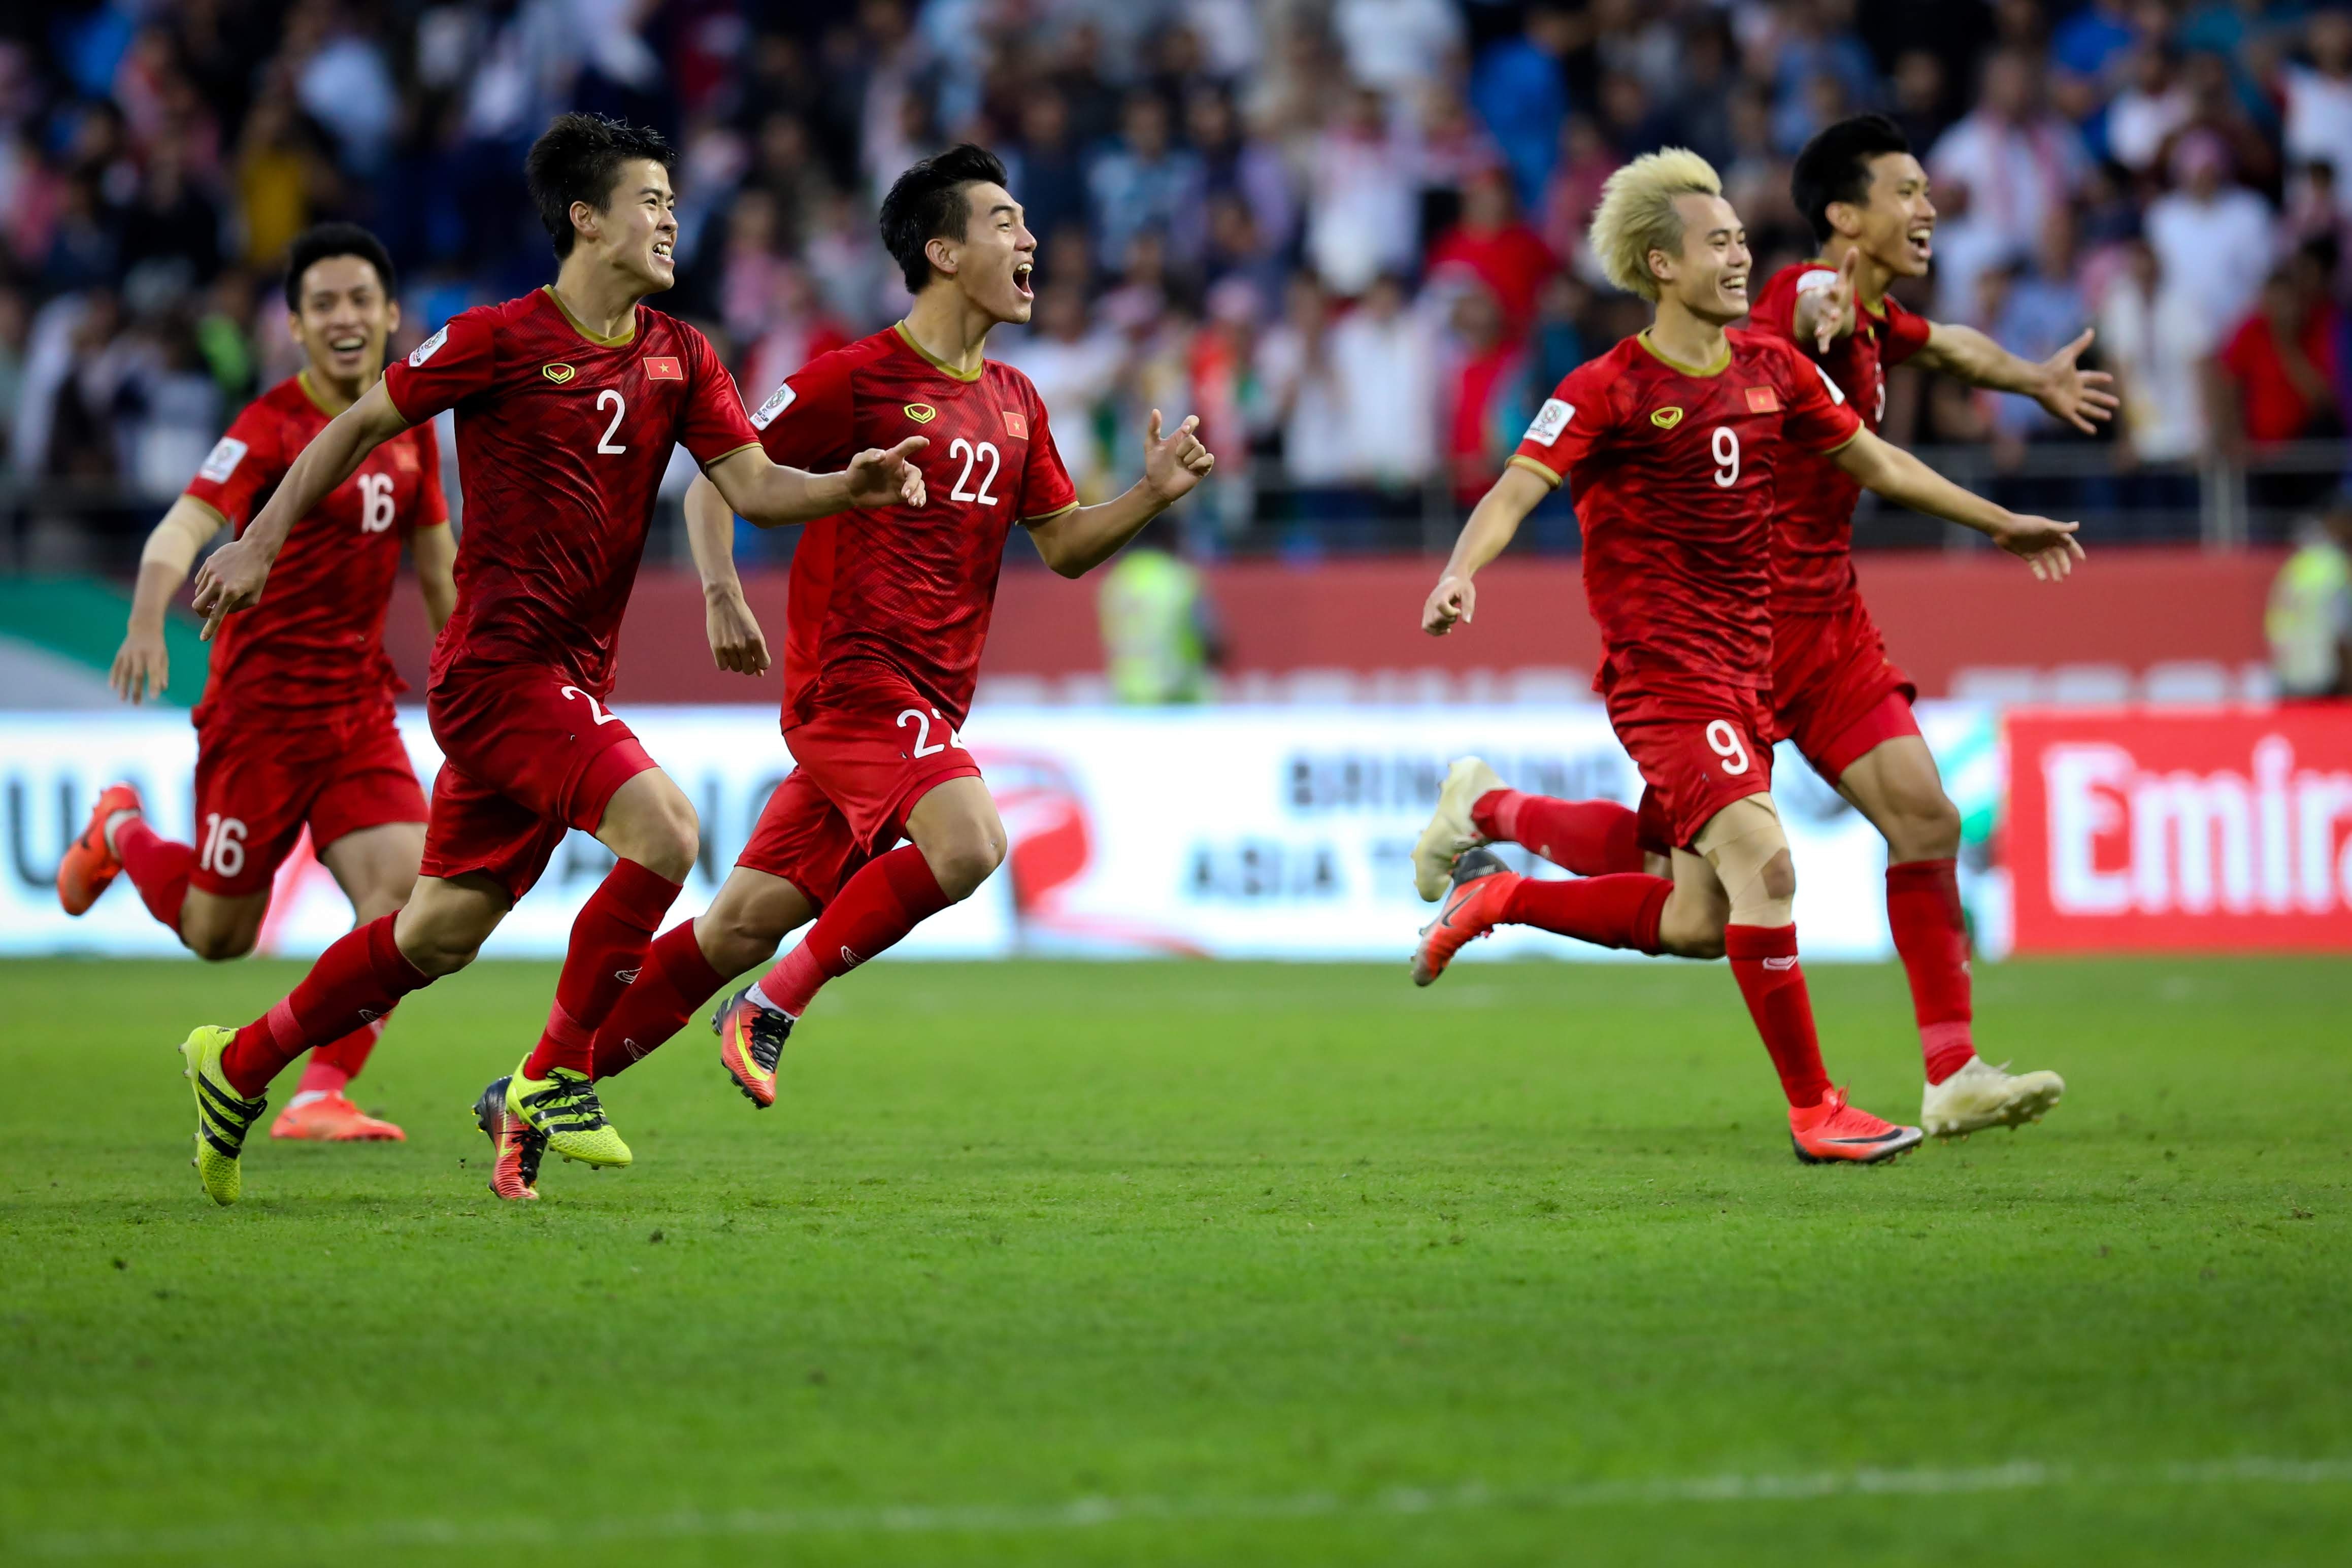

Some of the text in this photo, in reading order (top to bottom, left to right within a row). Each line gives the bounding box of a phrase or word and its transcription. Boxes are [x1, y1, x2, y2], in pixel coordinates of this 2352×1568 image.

[597, 390, 626, 454] 2
[950, 438, 1000, 506] 22
[1712, 427, 1739, 487] 9
[358, 474, 394, 530] 16
[561, 686, 617, 725] 2
[1706, 720, 1748, 775] 9
[203, 814, 245, 874] 16
